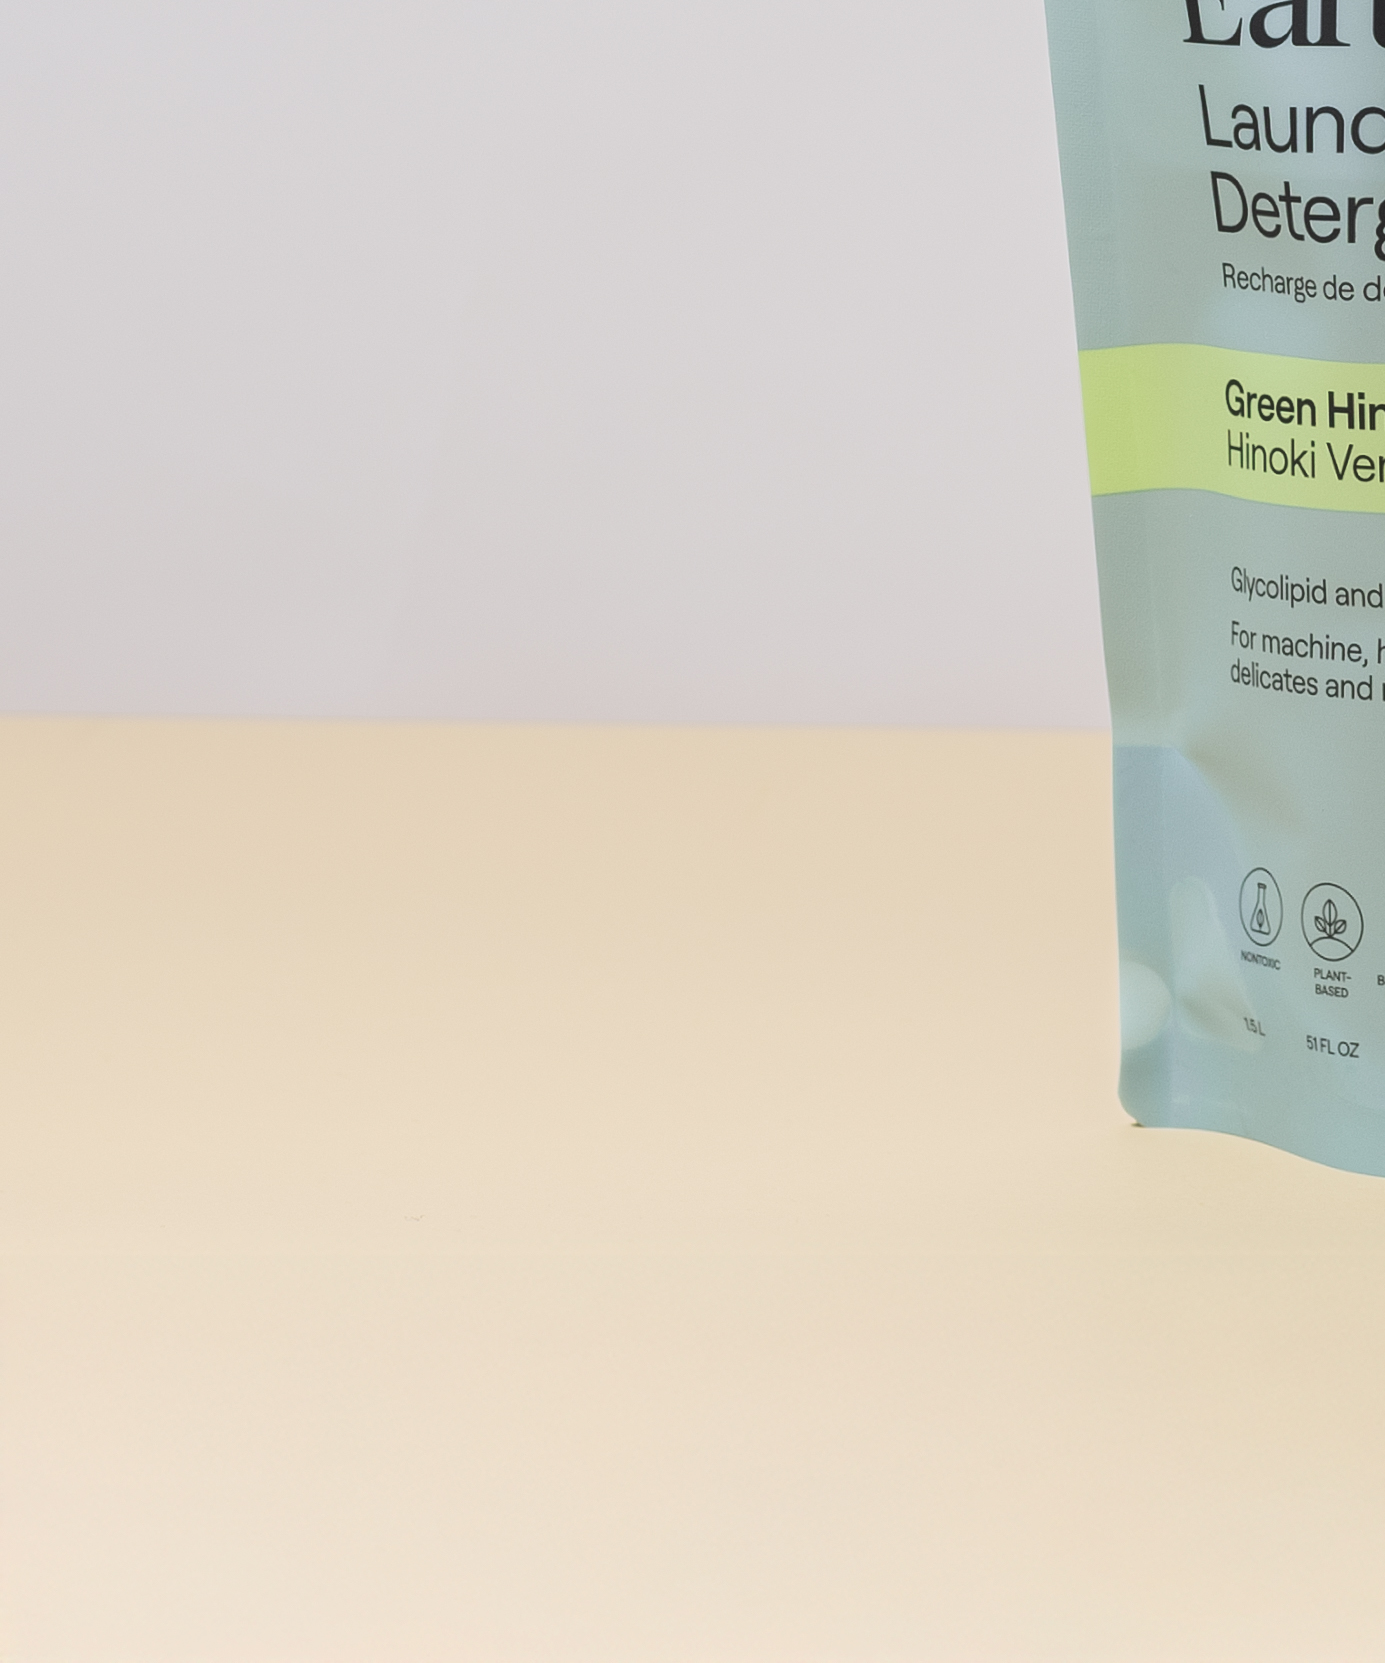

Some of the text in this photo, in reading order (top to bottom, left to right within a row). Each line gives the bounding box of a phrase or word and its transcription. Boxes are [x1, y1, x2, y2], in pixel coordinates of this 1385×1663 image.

[1221, 262, 1317, 304] Recharge
[1322, 274, 1355, 302] de
[1225, 378, 1317, 427] Green
[1227, 429, 1316, 479] Hinoki
[1231, 566, 1327, 609] Glycolipid
[1335, 582, 1384, 609] and
[1231, 620, 1257, 650] For
[1262, 633, 1368, 668] machine,
[1230, 658, 1319, 696] delicates
[1325, 674, 1373, 701] and
[1240, 950, 1281, 971] NONTOXIC
[1313, 967, 1352, 982] PLANT-
[1315, 983, 1349, 999] BASED
[1257, 1021, 1266, 1037] L
[1306, 1034, 1360, 1059] 51 FL OZ
